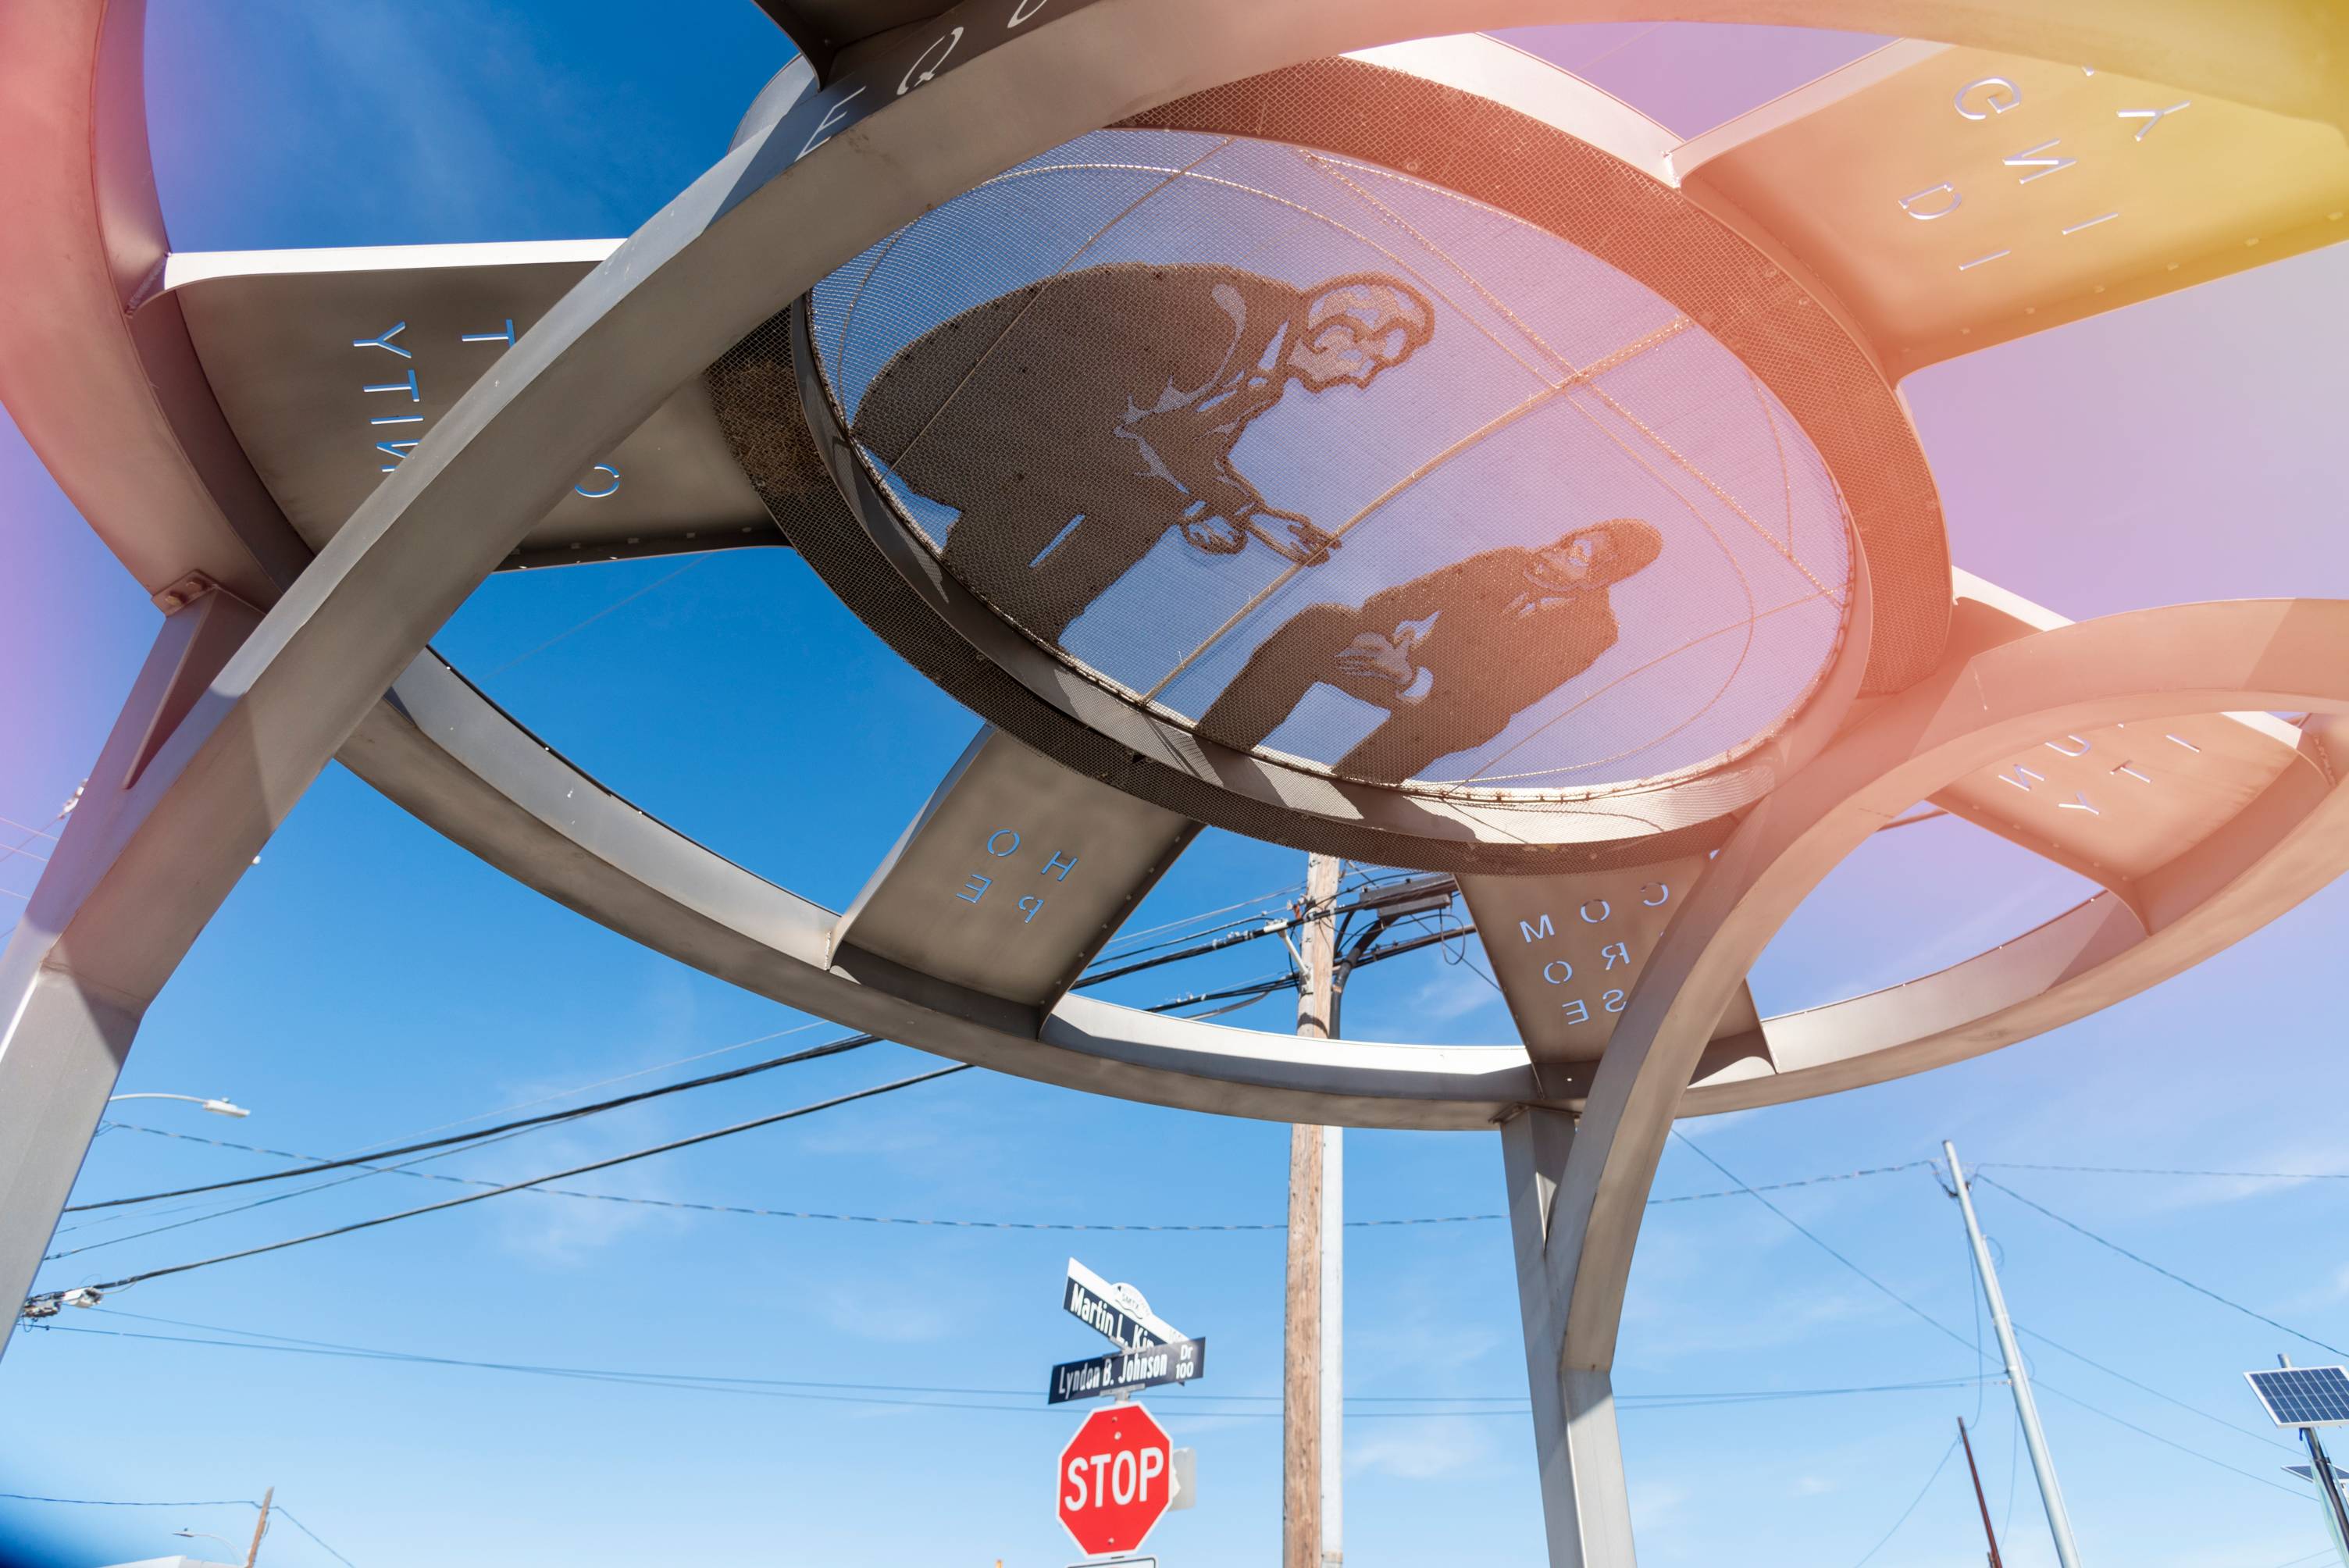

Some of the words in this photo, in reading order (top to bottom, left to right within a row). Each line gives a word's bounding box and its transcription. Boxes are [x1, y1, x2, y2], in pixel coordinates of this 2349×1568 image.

[1070, 1283, 1114, 1337] Martin
[1116, 1313, 1128, 1347] L.
[1132, 1324, 1154, 1350] Ki
[1175, 1361, 1194, 1380] 100
[1180, 1344, 1193, 1361] Dr
[1059, 1363, 1100, 1399] Lyndon
[1103, 1359, 1114, 1386] B.
[1118, 1353, 1168, 1383] Johnson
[1064, 1446, 1164, 1512] STOP
